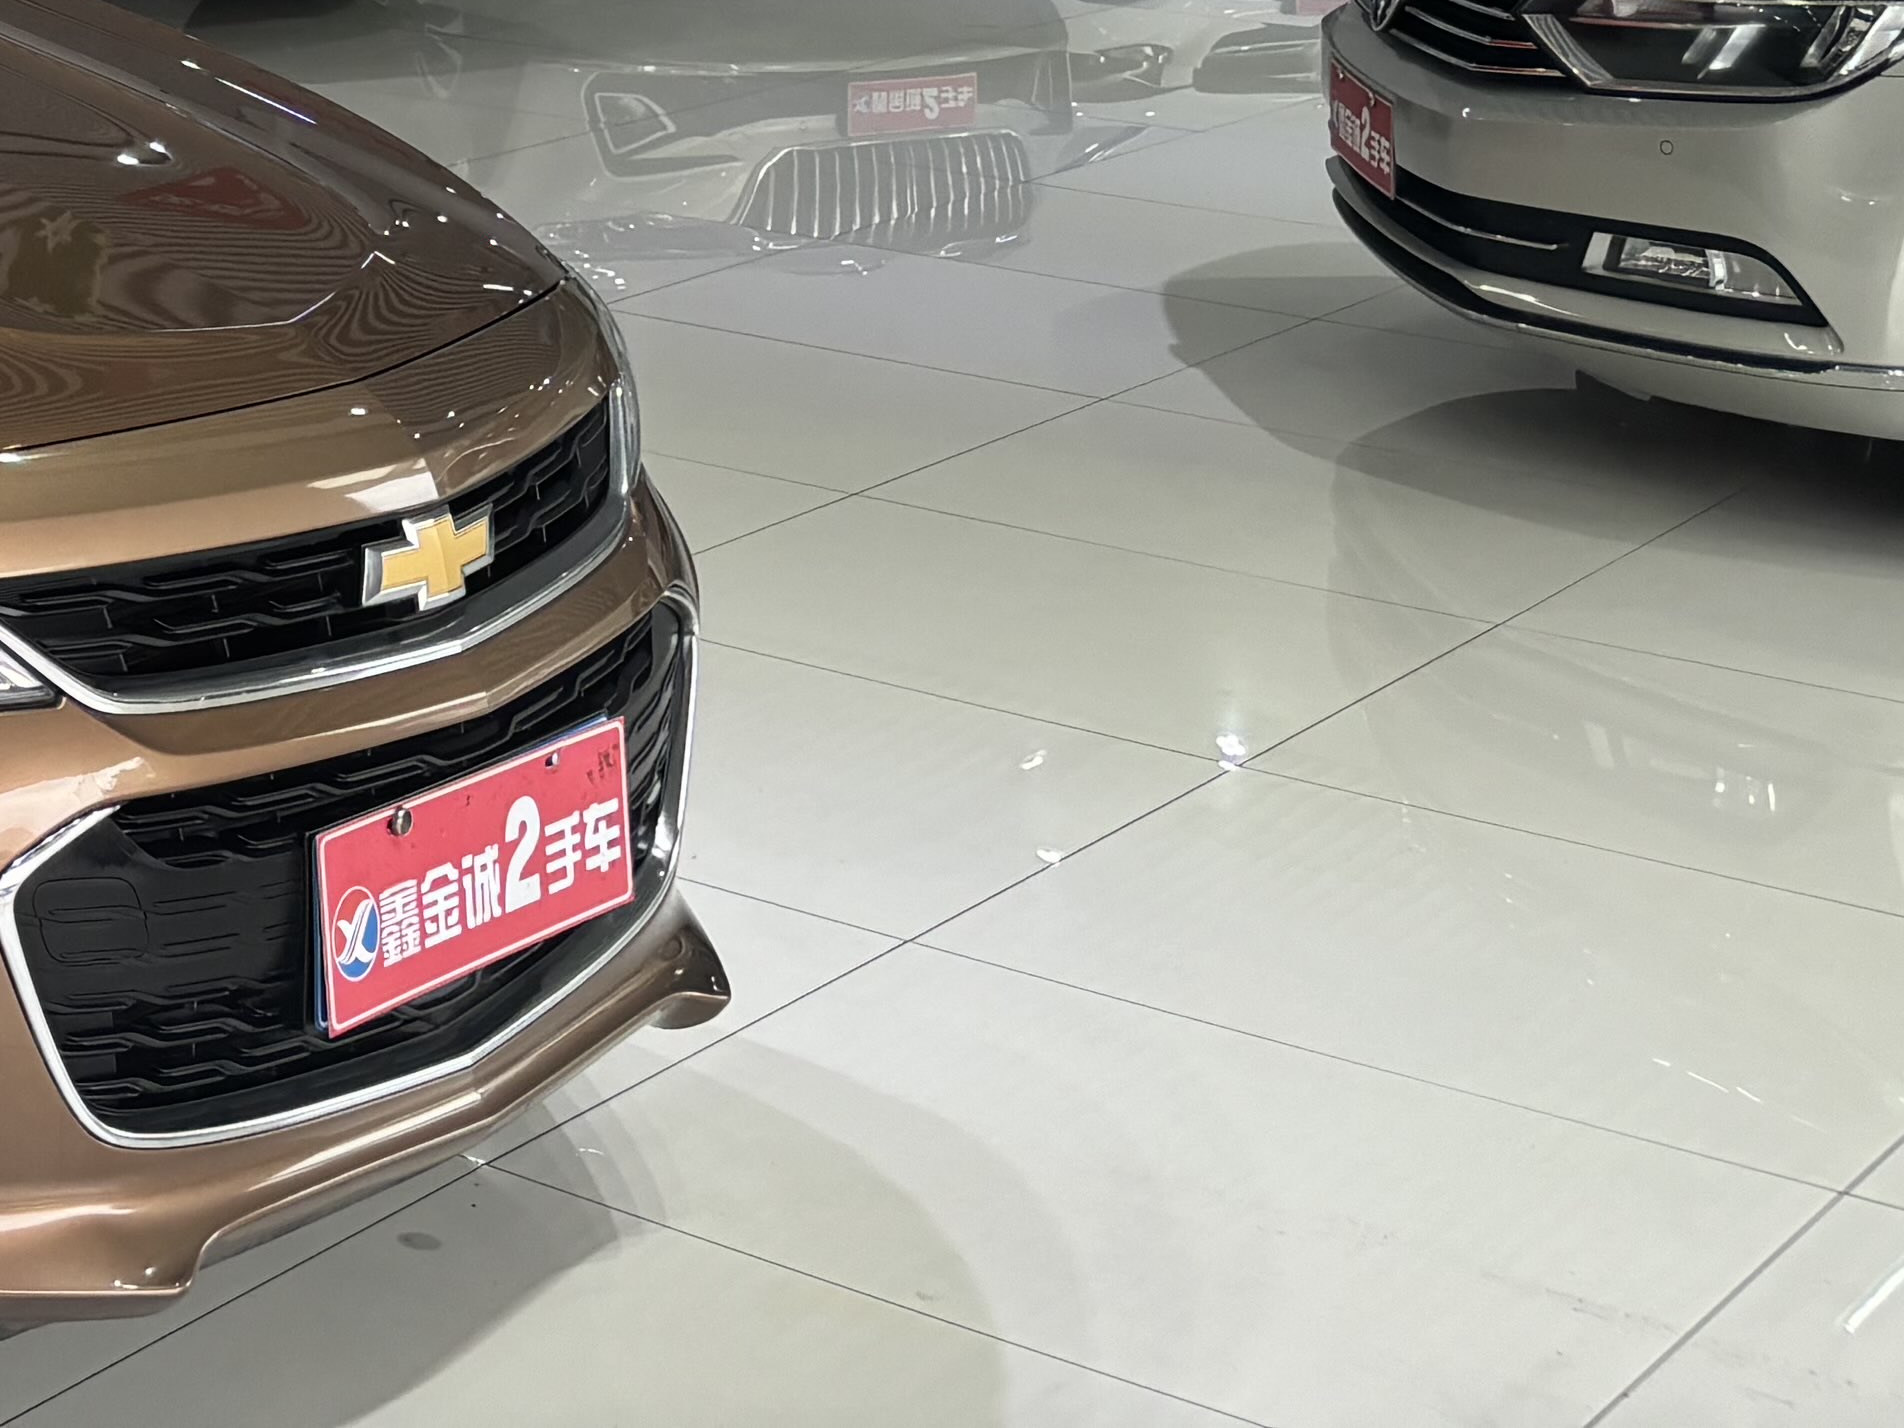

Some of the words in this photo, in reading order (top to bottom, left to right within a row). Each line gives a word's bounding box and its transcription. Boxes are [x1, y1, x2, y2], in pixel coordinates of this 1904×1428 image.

[378, 794, 622, 969] 鑫金诚2手车
